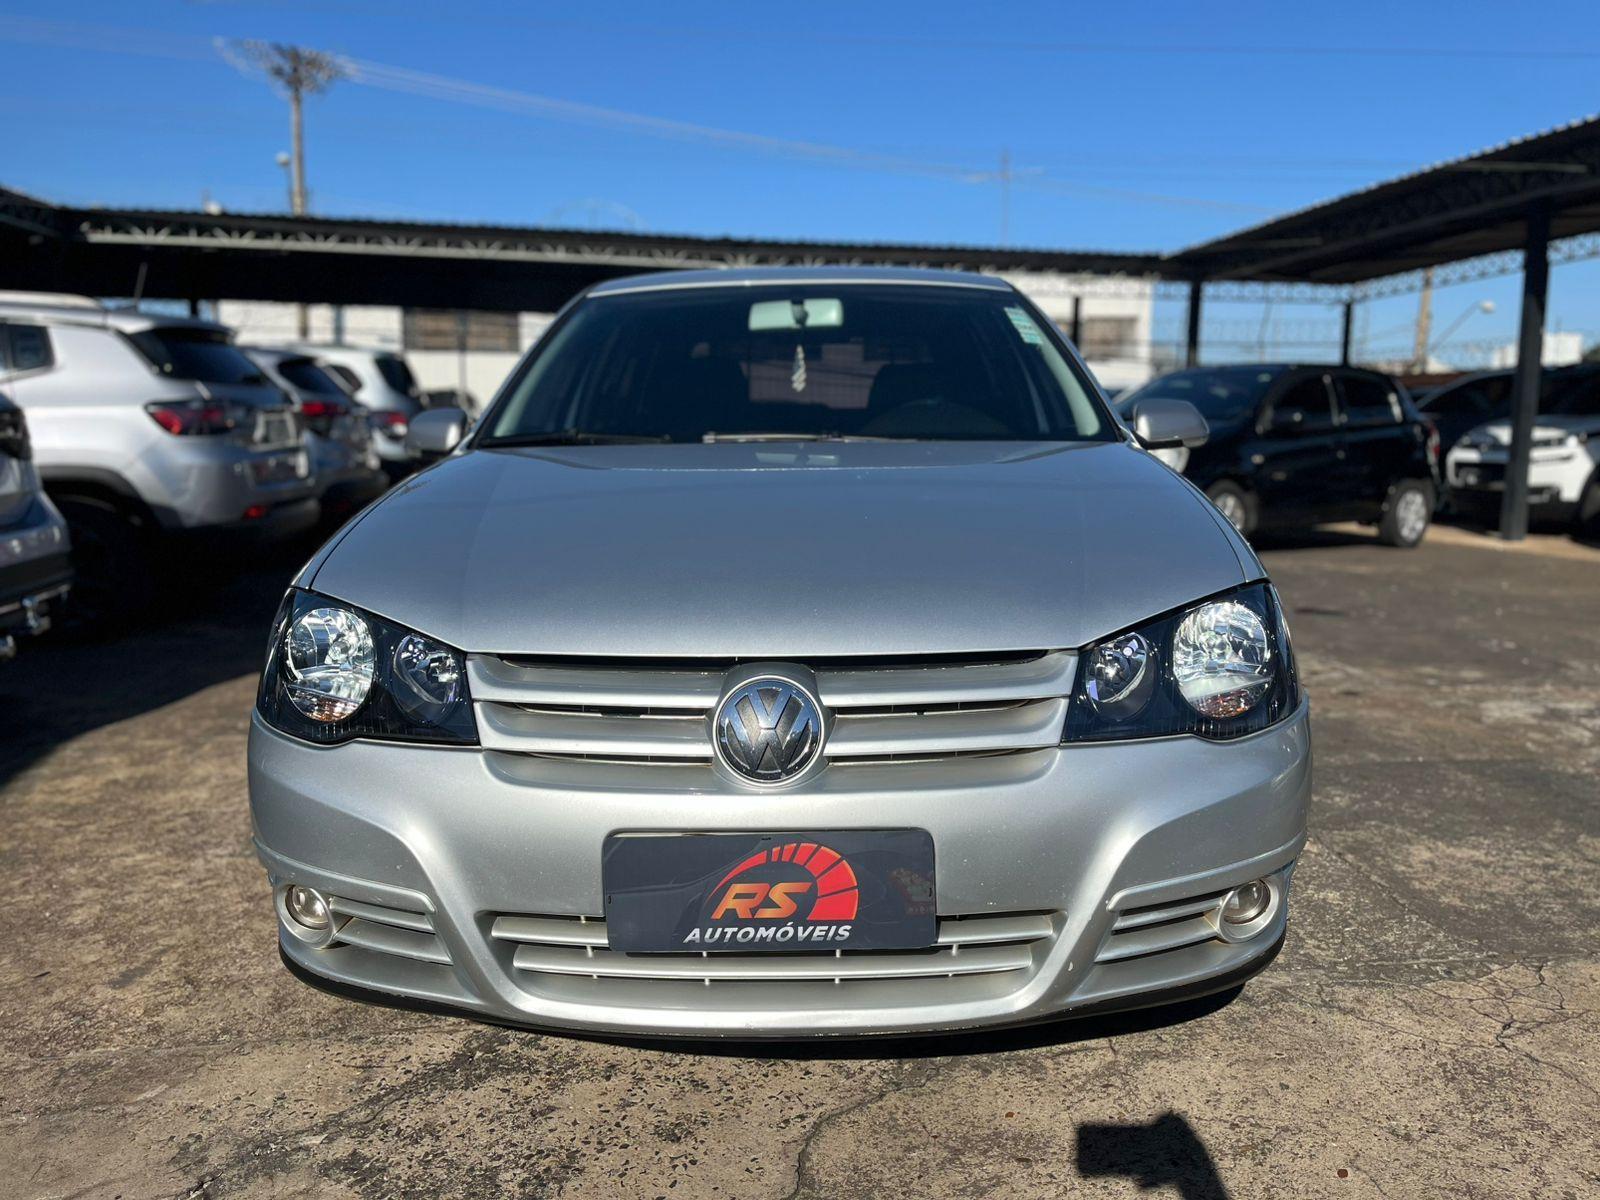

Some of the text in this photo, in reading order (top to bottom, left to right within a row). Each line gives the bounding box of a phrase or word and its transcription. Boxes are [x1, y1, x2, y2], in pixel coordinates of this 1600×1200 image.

[718, 680, 820, 782] VW
[710, 882, 812, 919] RS
[683, 922, 852, 944] AUTOMÓVEIS
